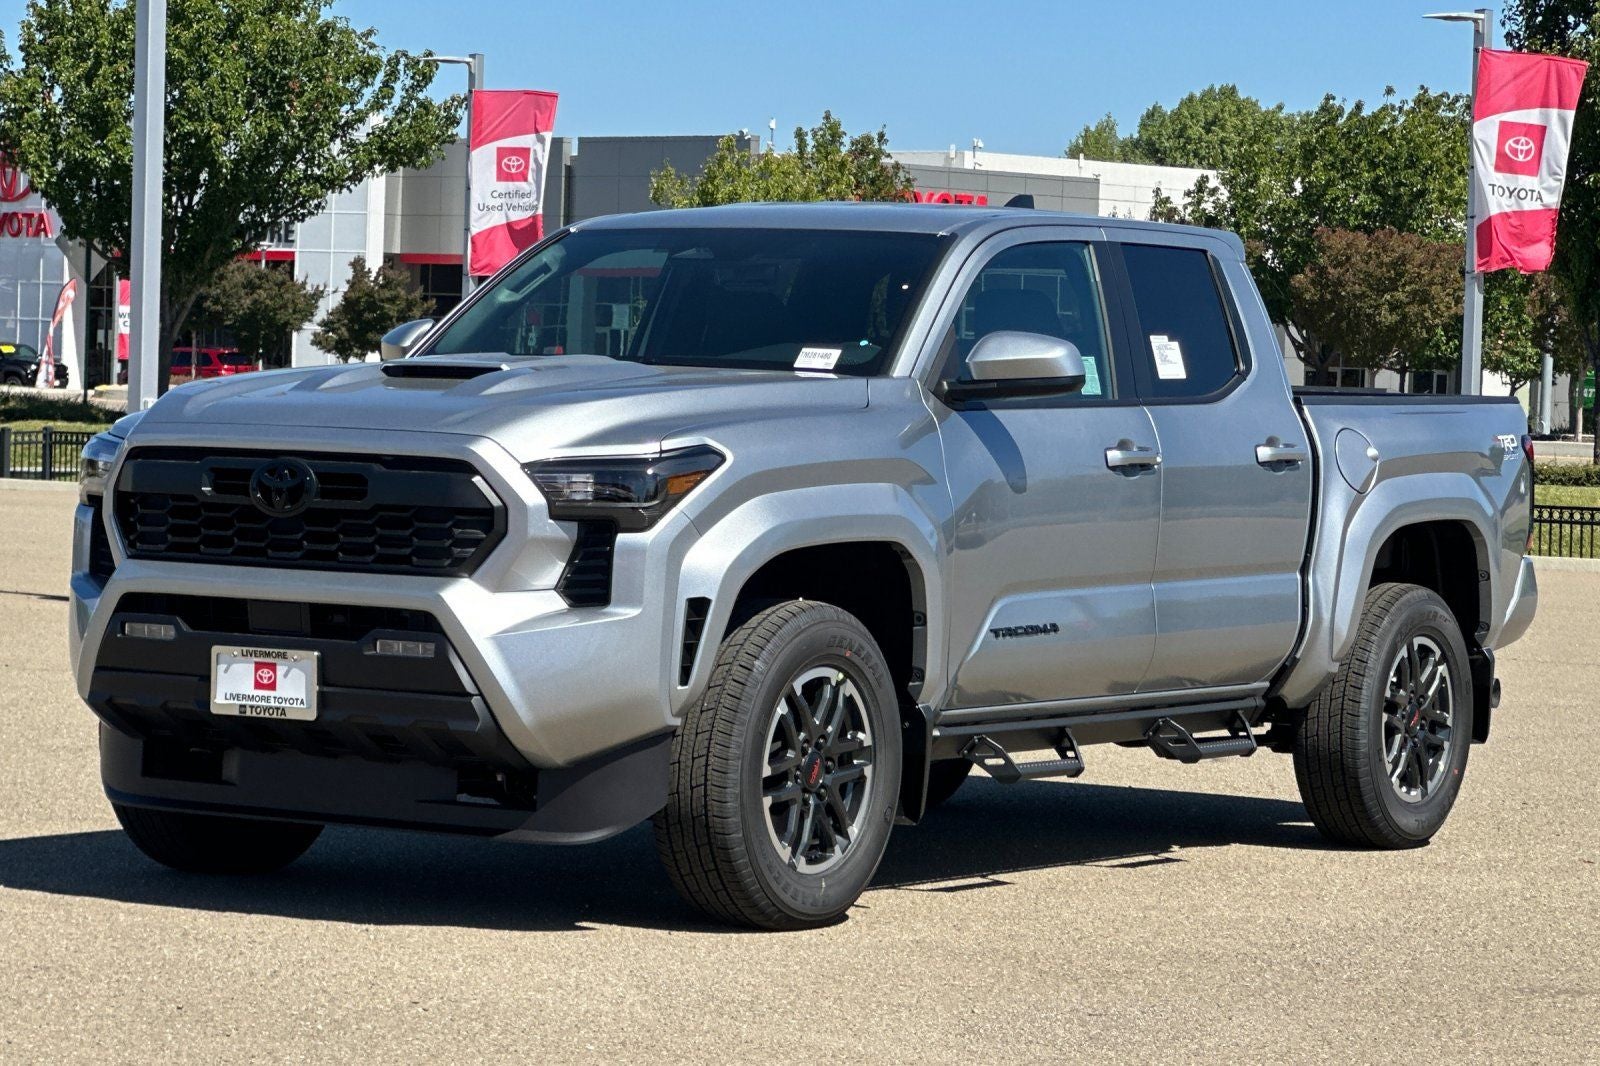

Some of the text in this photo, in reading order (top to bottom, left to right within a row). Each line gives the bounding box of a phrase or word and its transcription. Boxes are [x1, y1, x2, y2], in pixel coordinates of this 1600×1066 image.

[490, 189, 532, 199] Certified
[1488, 183, 1544, 203] TOYOTA
[477, 202, 539, 212] Used Vehicles
[1497, 434, 1518, 451] TRD
[989, 622, 1060, 639] TACOMA
[241, 649, 288, 660] LIVERMORE
[224, 692, 305, 706] LIVERMORE TOYOTA
[248, 705, 287, 717] TOYOTA
